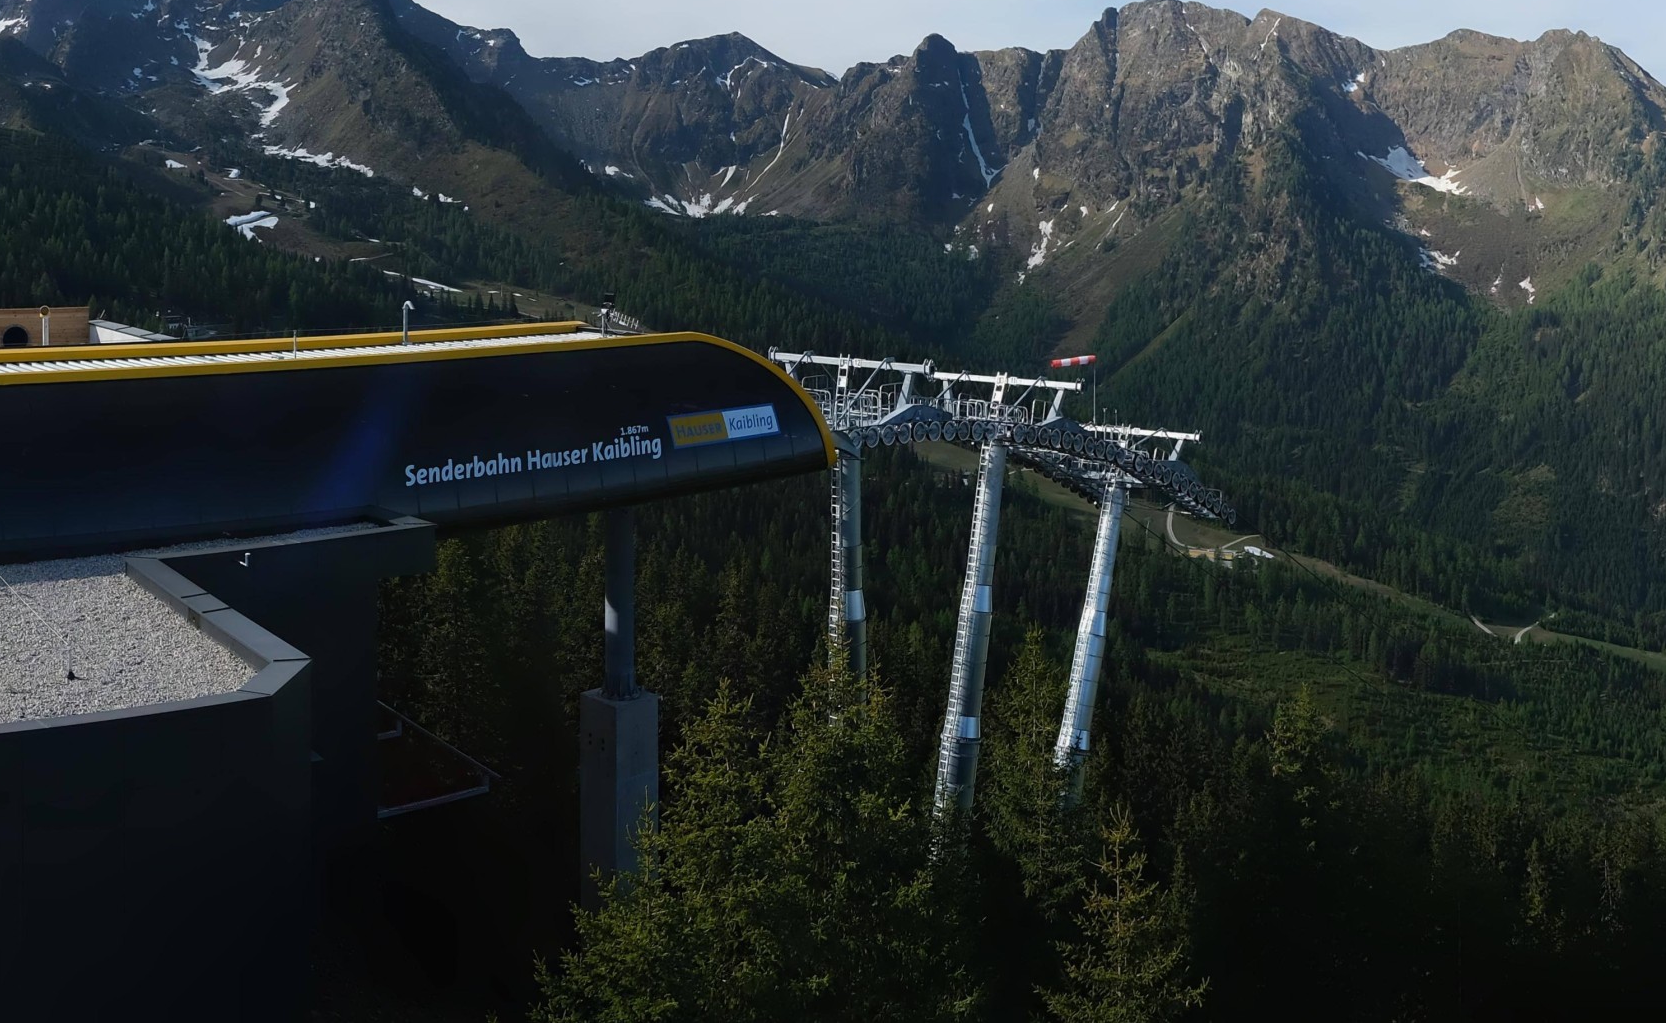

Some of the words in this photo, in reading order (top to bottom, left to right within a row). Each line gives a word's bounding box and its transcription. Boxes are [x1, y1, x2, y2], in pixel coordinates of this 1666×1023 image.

[620, 424, 650, 437] 1.867m
[728, 413, 773, 431] Kaibling
[405, 452, 522, 487] Senderbahn
[527, 446, 589, 471] Hauser
[592, 435, 662, 462] Kaibling
